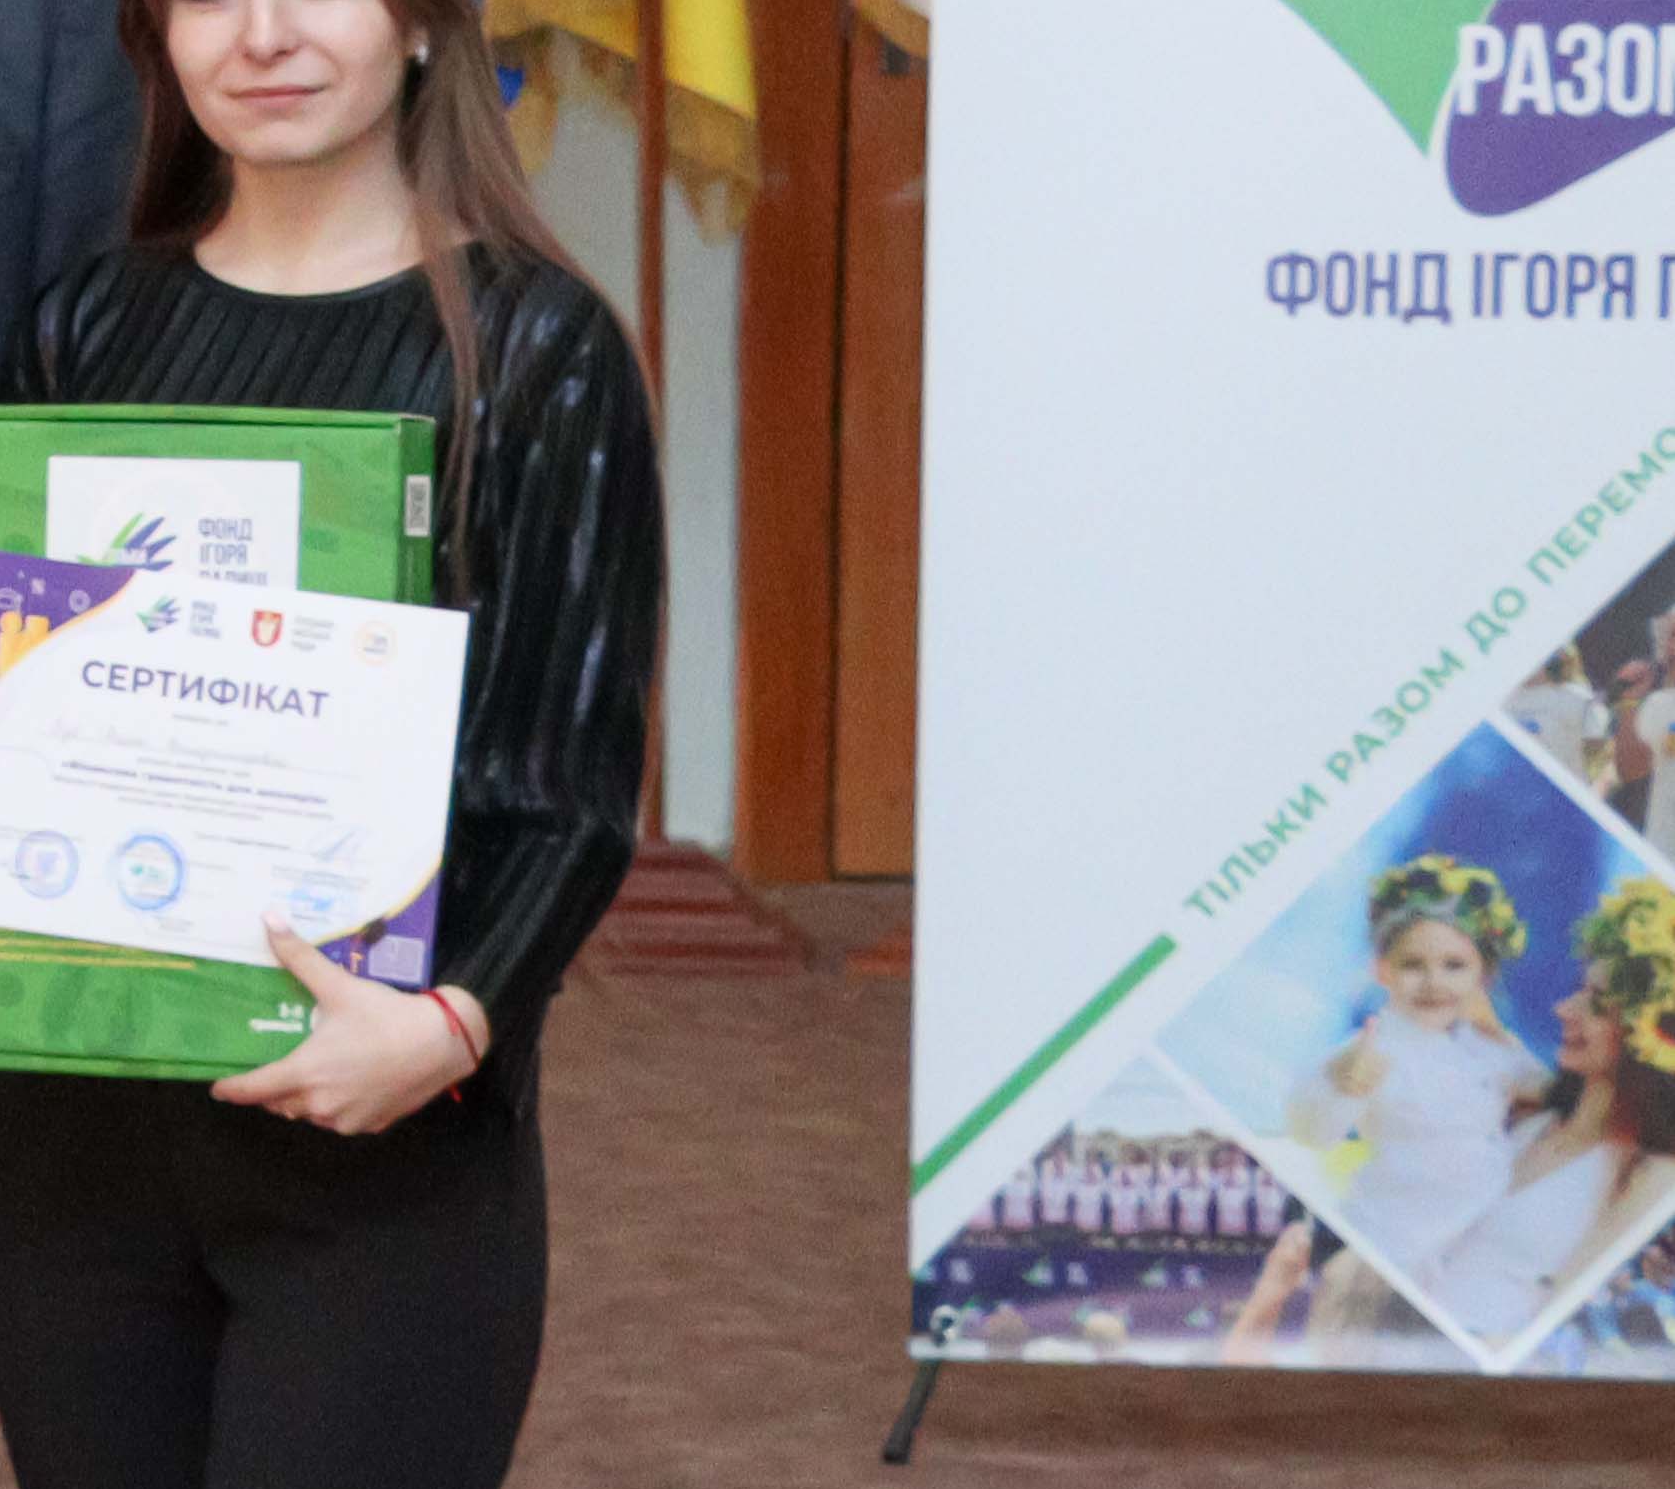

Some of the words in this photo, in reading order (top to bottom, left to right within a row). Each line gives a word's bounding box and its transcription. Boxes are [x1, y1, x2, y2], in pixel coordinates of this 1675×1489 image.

[1266, 251, 1454, 325] ФОНД
[1471, 252, 1636, 319] ІГОРЯ
[82, 659, 329, 719] СЕРТИФІКАТ
[1183, 782, 1328, 918] ТІЛЬКИ
[1326, 648, 1466, 783] РАЗОМ
[1464, 586, 1527, 655] ДО
